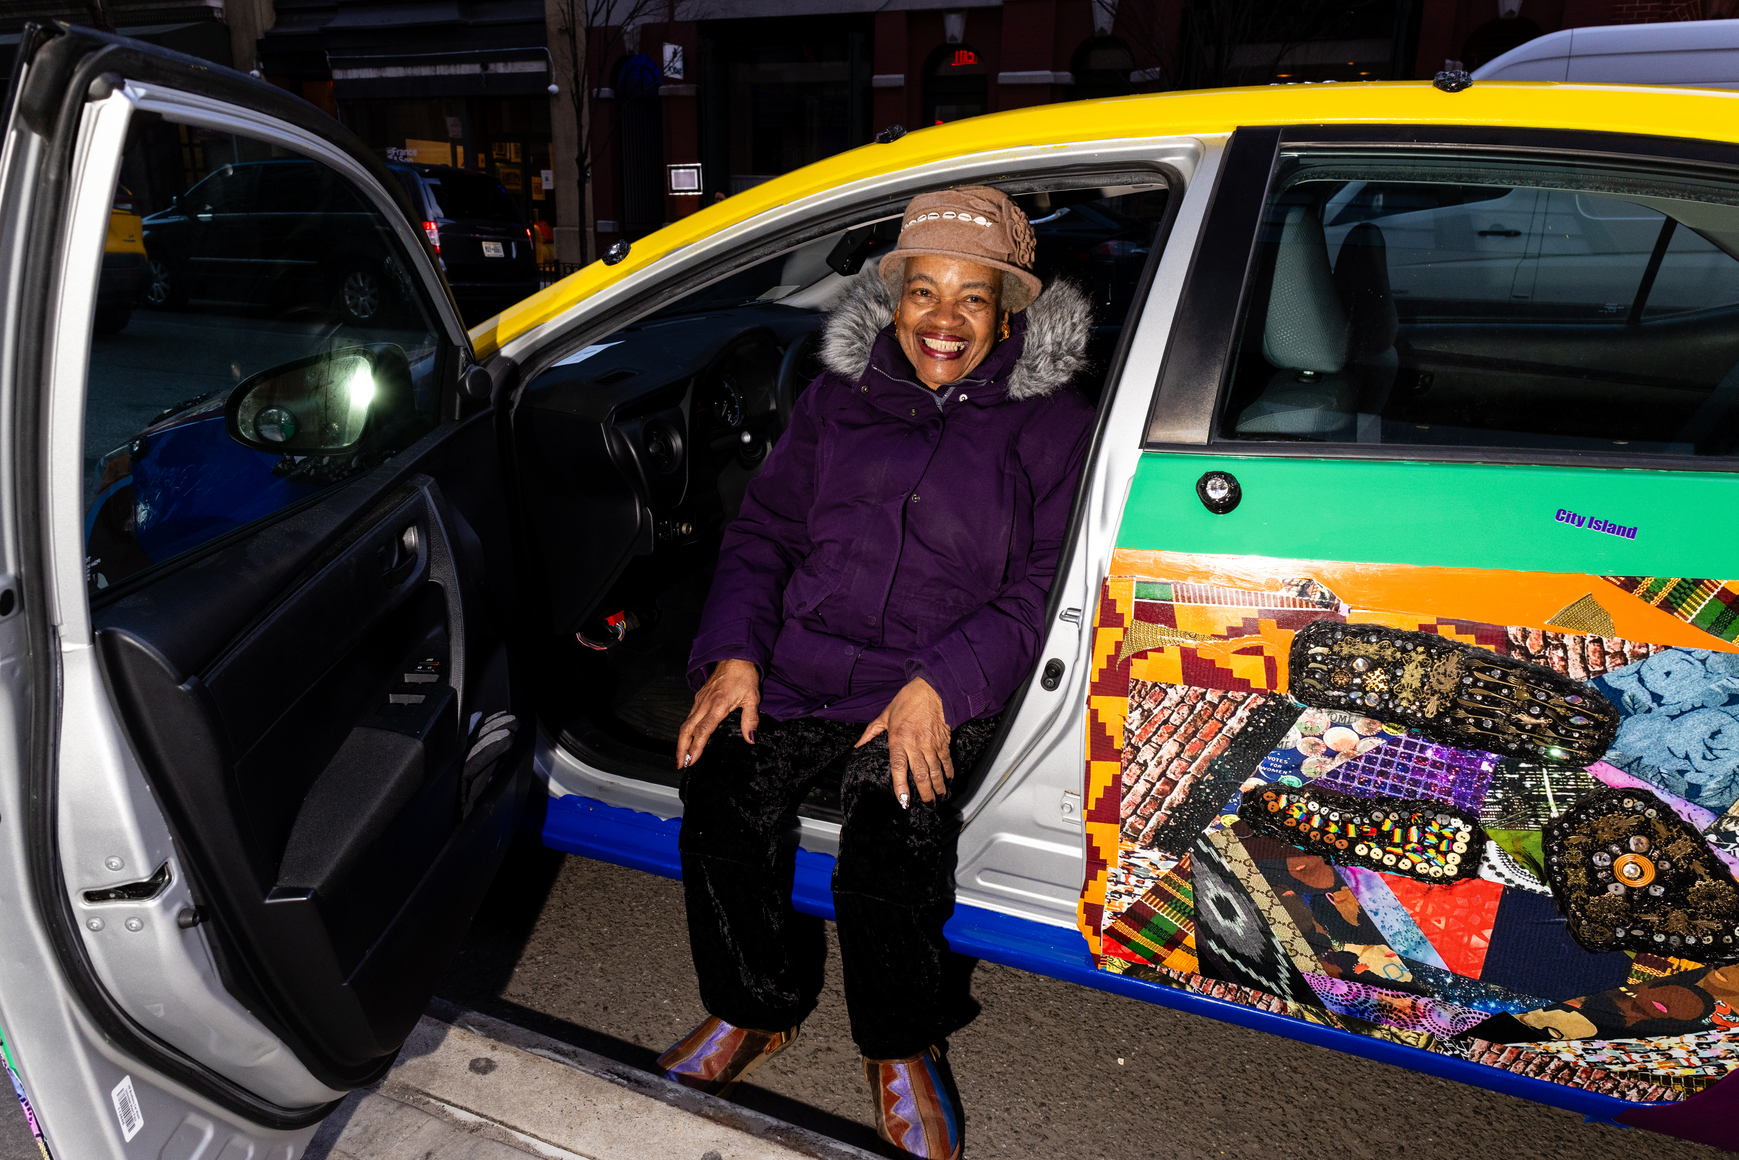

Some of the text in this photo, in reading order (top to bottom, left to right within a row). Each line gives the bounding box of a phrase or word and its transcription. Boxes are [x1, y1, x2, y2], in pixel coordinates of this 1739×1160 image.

[392, 147, 417, 156] France
[1555, 508, 1638, 540] City Island
[1267, 756, 1288, 765] VOTES
[1261, 766, 1288, 775] WOMEN
